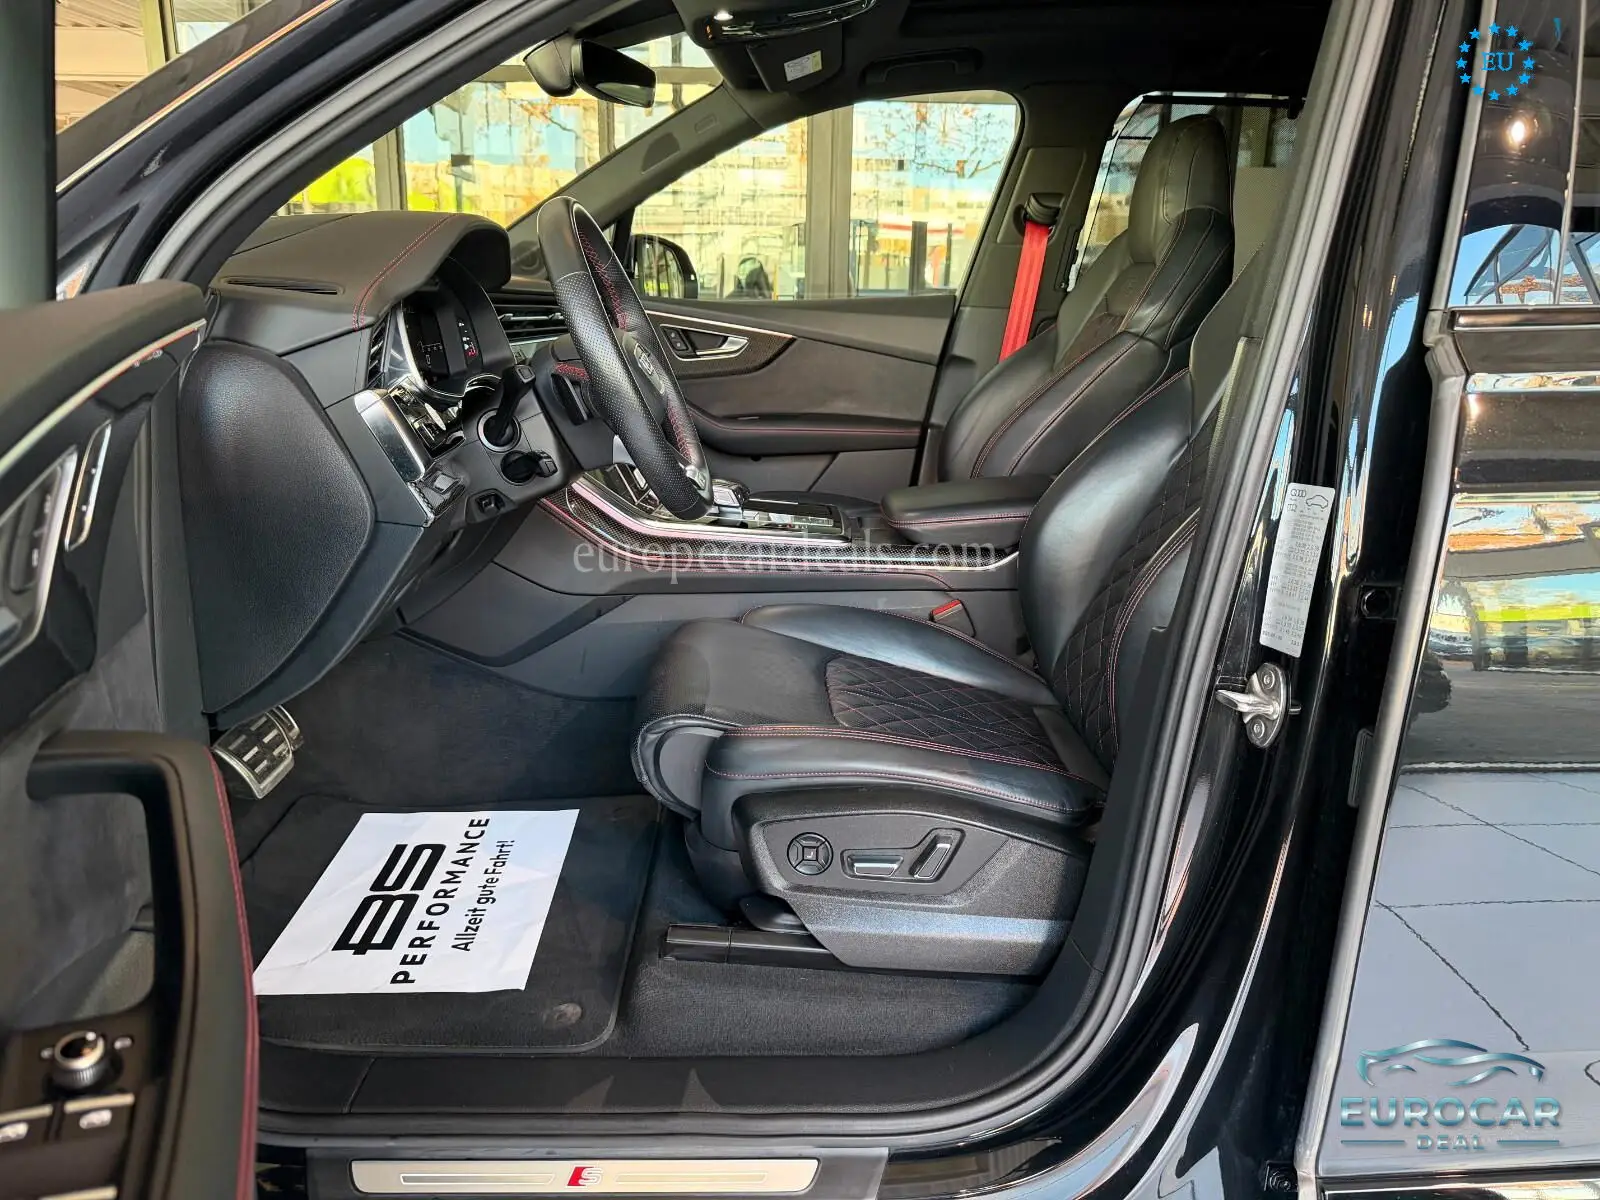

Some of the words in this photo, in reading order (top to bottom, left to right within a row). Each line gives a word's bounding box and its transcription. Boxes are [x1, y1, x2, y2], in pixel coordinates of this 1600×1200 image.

[483, 840, 515, 875] Fahrt!
[390, 817, 490, 984] PERFORMANCE
[476, 877, 499, 904] gute
[451, 907, 487, 952] Allzeit
